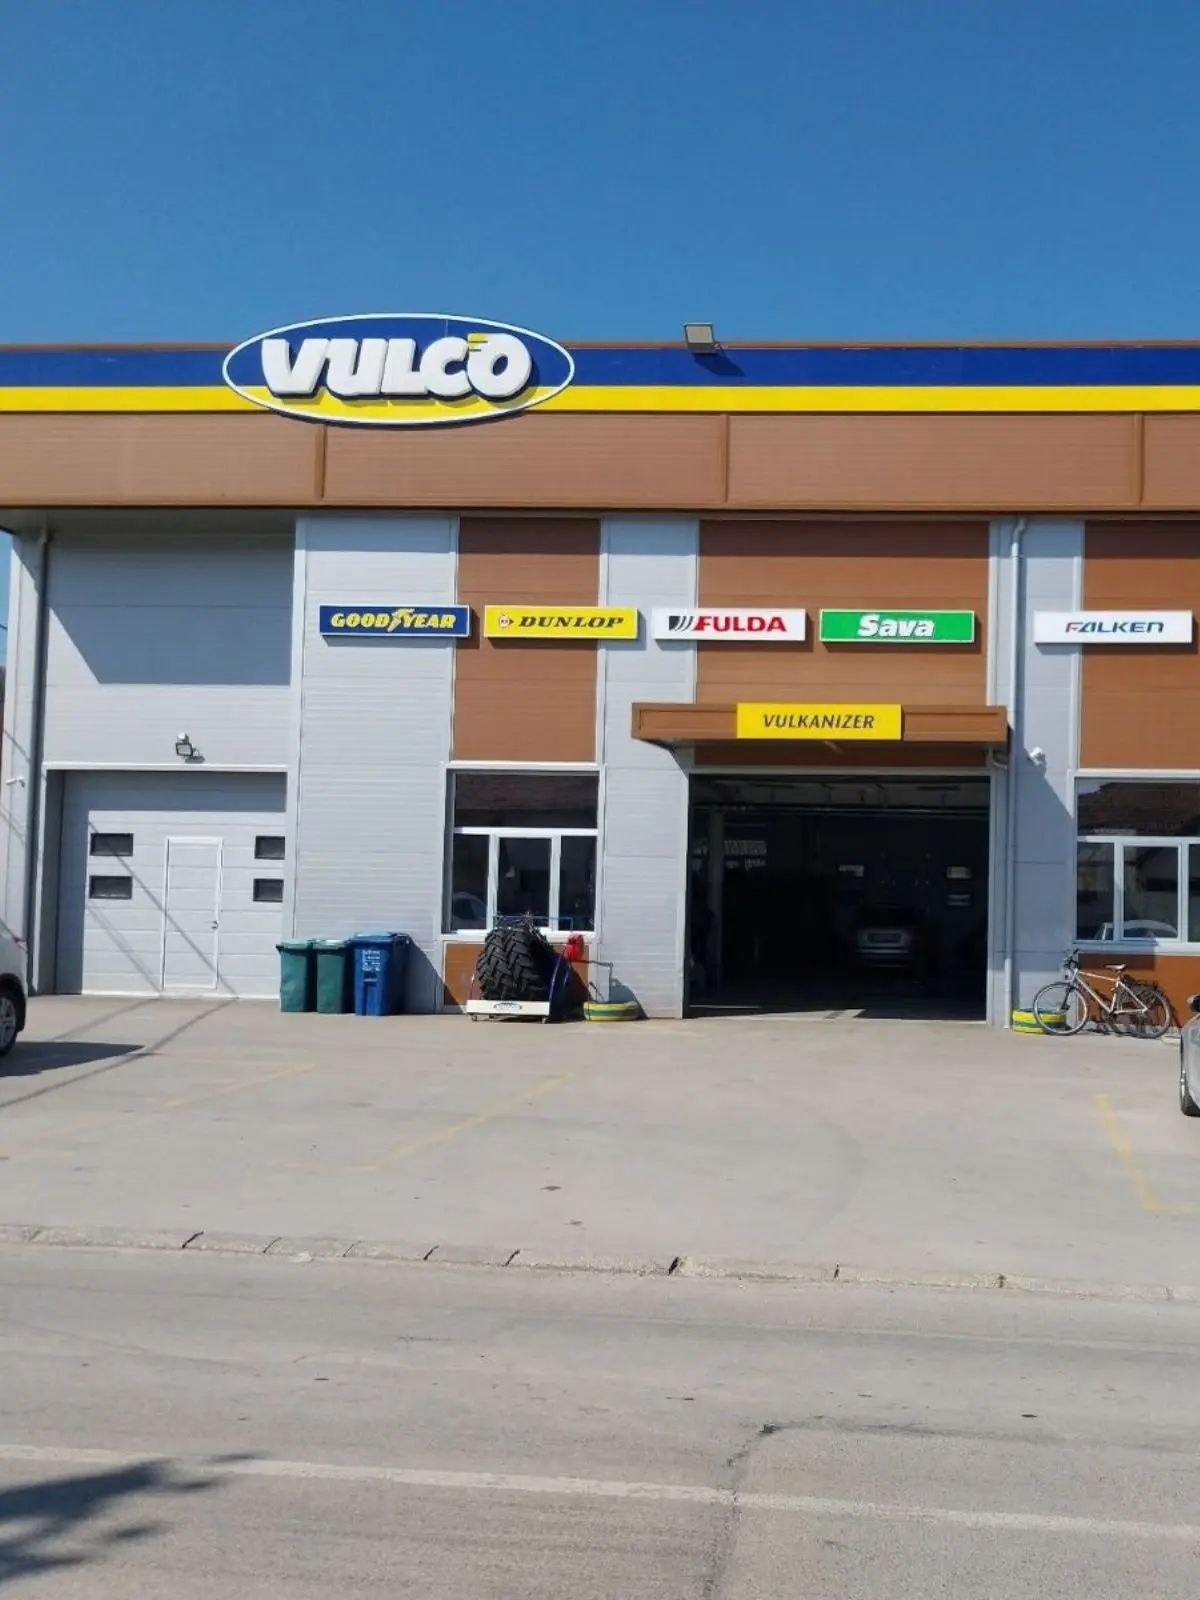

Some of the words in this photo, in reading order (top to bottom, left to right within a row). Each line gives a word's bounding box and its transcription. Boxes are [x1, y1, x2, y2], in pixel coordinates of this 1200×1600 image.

[261, 333, 532, 398] VULCO
[330, 608, 457, 632] GOODYEAR
[518, 615, 625, 628] DUNLOP
[693, 615, 787, 632] FULDA
[857, 614, 935, 637] Sava
[1065, 622, 1164, 633] FALKEN
[763, 714, 875, 729] VULKANIZER
